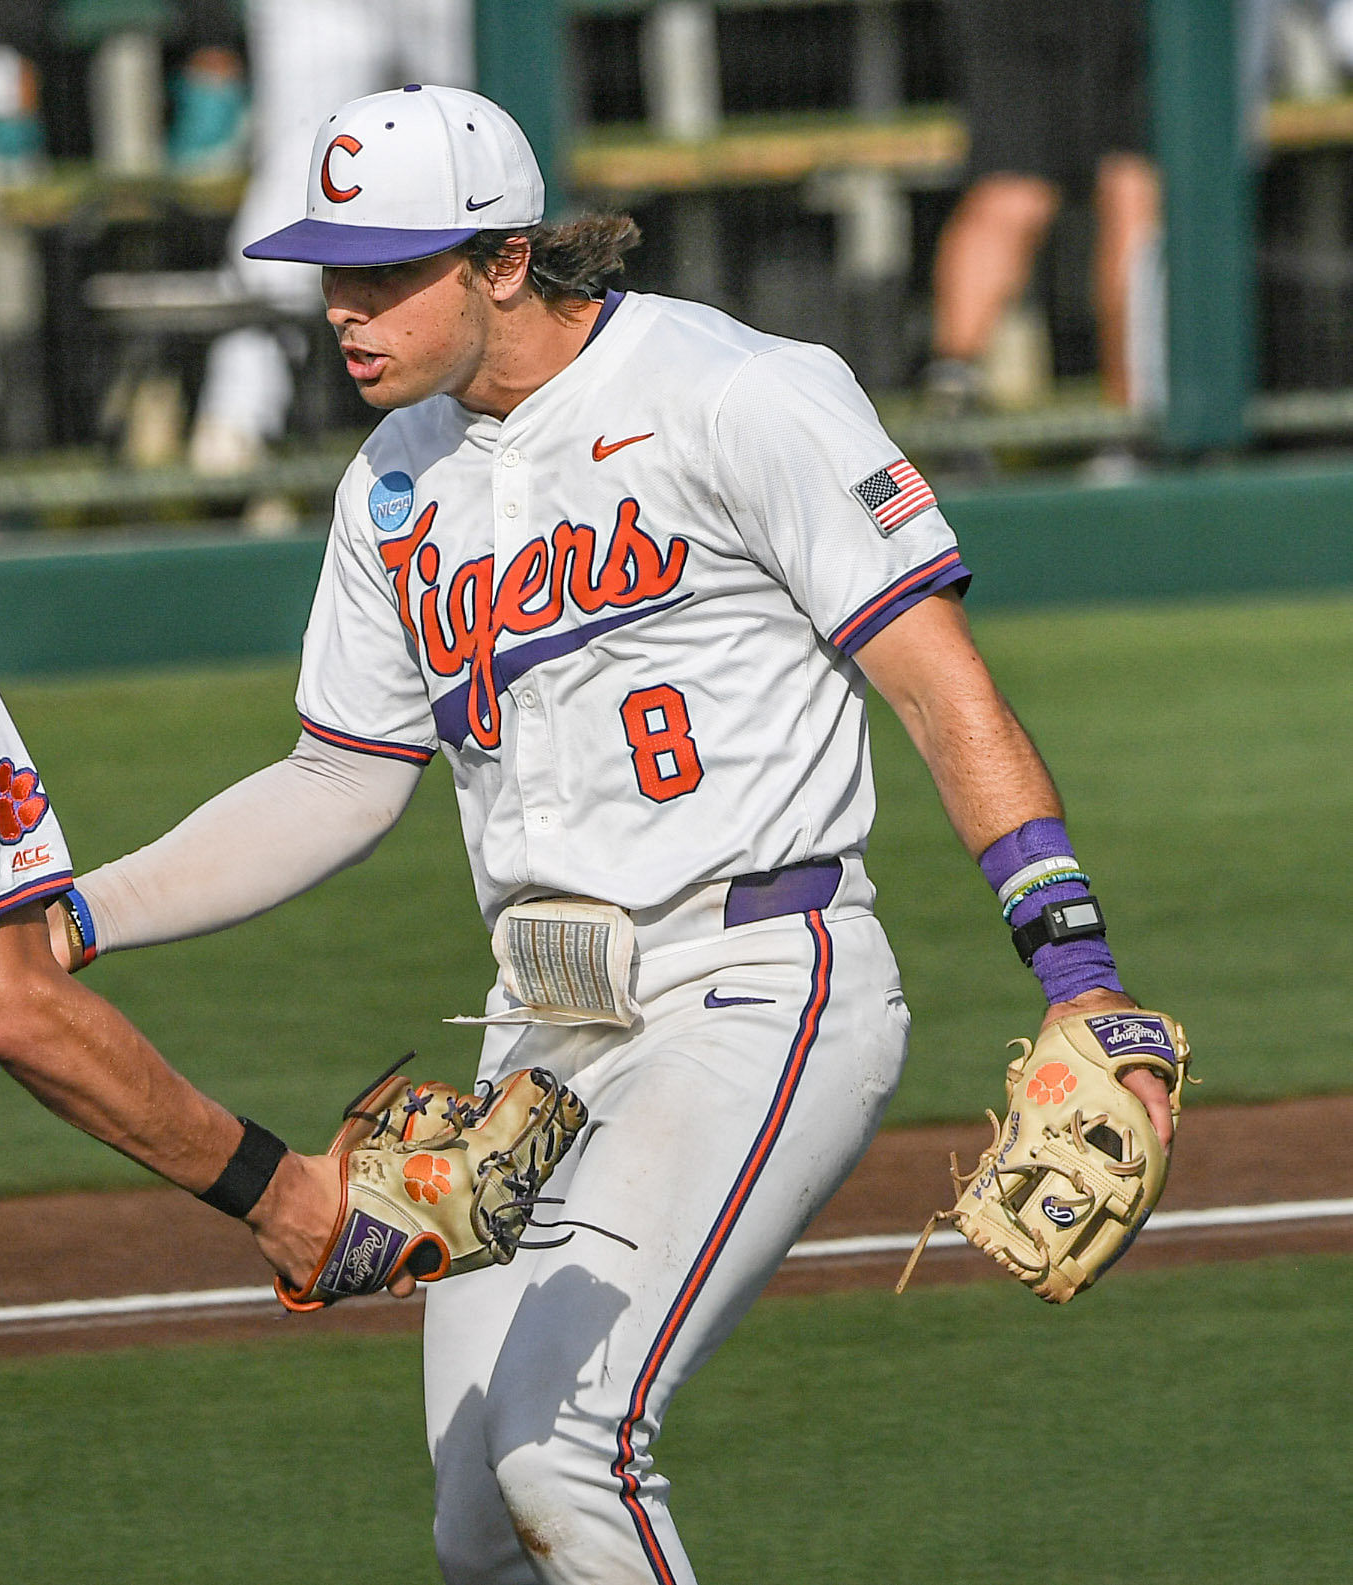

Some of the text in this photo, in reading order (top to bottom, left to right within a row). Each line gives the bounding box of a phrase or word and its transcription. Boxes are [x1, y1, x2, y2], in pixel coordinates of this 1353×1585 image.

[321, 134, 363, 203] C
[376, 495, 410, 520] NCAA
[378, 497, 689, 750] Tigers
[620, 683, 704, 804] 8
[12, 843, 50, 868] ACC
[1107, 1024, 1164, 1045] Rawlings
[345, 1226, 384, 1286] Rawling
